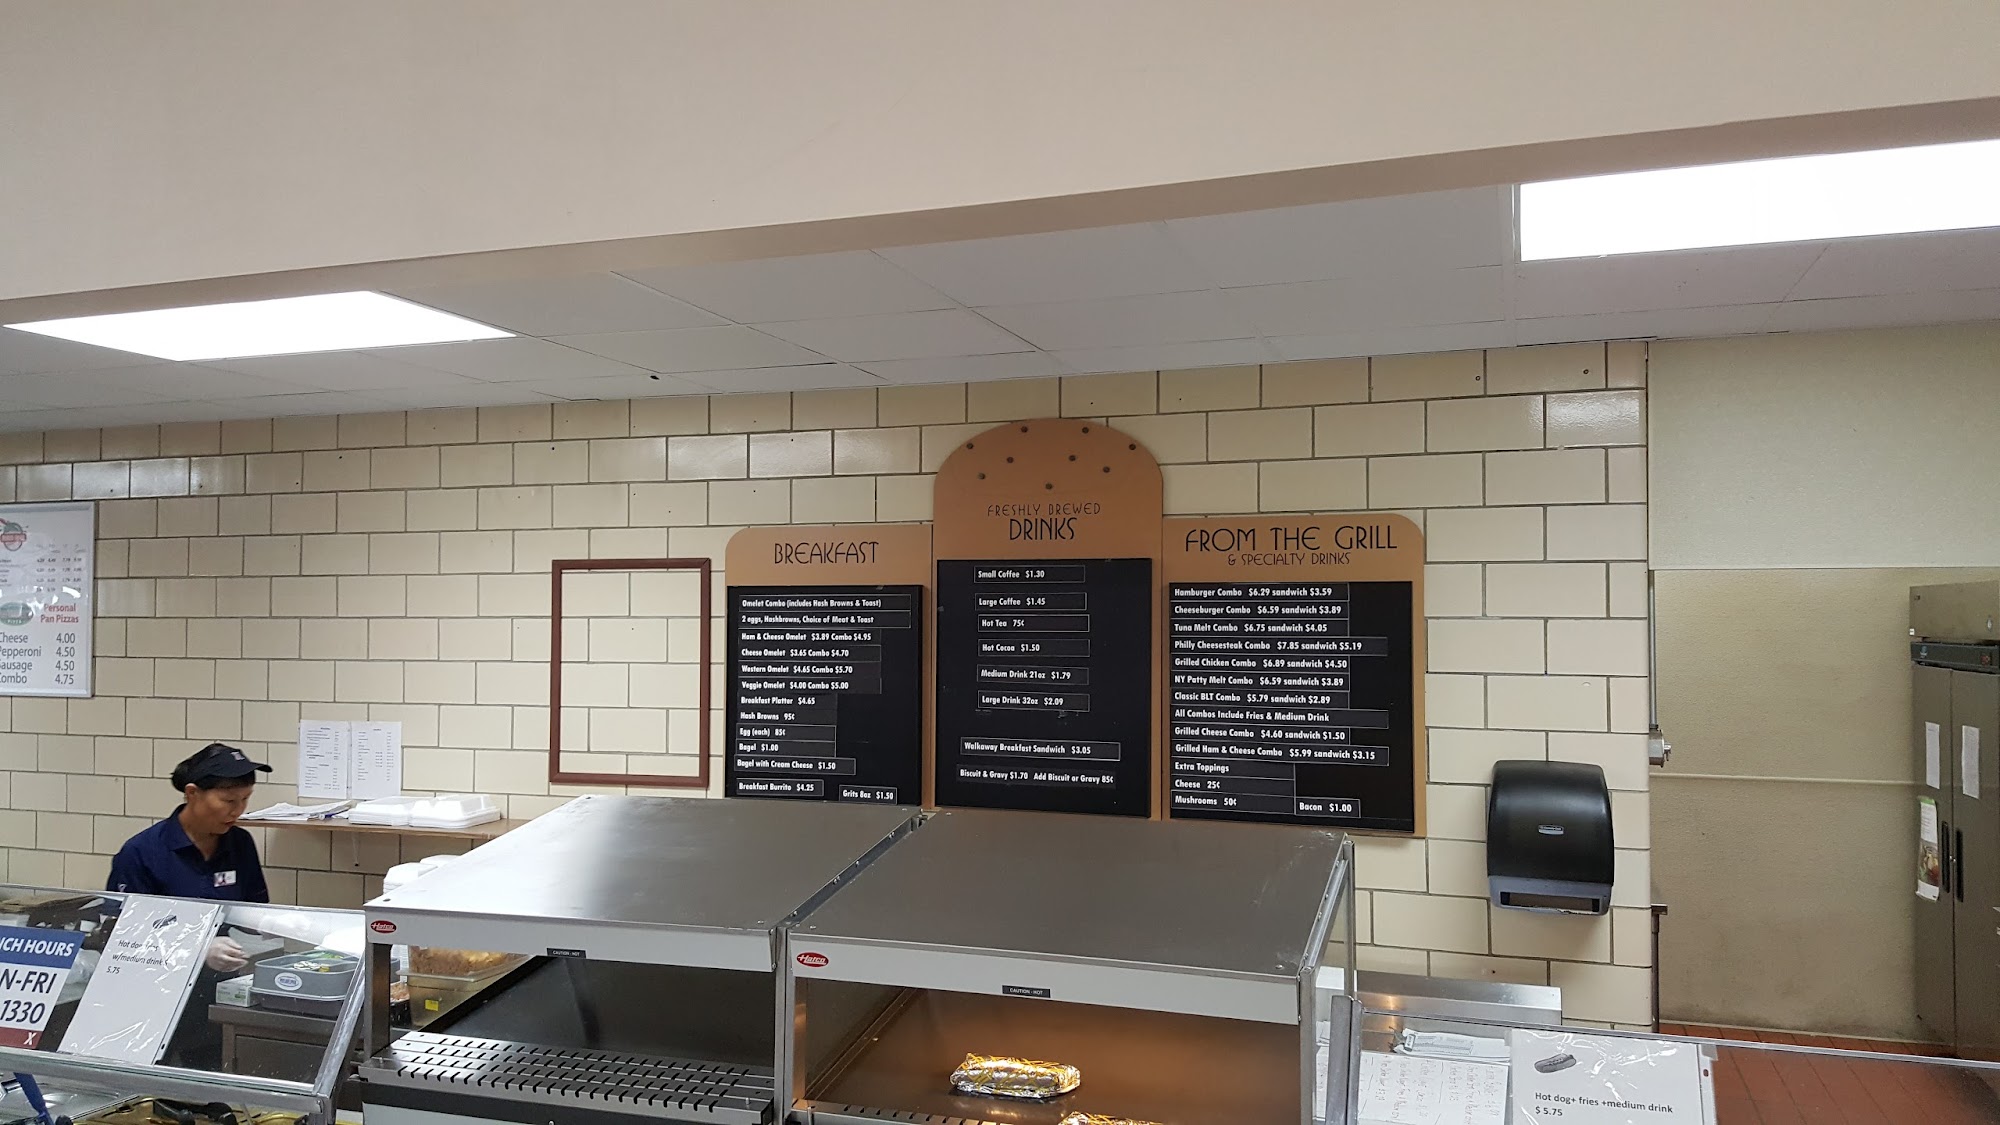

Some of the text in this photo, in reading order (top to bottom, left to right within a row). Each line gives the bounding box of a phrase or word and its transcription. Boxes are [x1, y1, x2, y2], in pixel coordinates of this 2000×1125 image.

[988, 503, 1100, 516] FRESHLY BREWED
[1010, 517, 1077, 540] DRINKS
[1186, 525, 1397, 551] FROM THE GRILL
[775, 541, 879, 564] BREAKFAST
[1228, 552, 1350, 565] & SPECIALTY DRINKS
[998, 570, 1019, 578] Coffee
[1026, 570, 1044, 578] $1.30
[1175, 588, 1332, 597] Hamburger Combo $6.29 sandwich $3.59
[979, 598, 997, 607] Large
[1027, 598, 1045, 606] $1.45
[44, 604, 76, 612] Personal
[1175, 606, 1224, 615] Cheeseburger
[1258, 606, 1279, 614] $6.59
[1319, 606, 1341, 614] $3.89
[41, 615, 79, 623] Pan Pizzas
[56, 633, 76, 643] 4.00
[812, 633, 829, 641] $3.89
[854, 633, 871, 641] $4.95
[1175, 641, 1195, 650] Philly
[1197, 641, 1242, 649] Cheesesteak
[1245, 641, 1270, 649] Combo
[1277, 642, 1299, 650] $7.85
[1340, 642, 1362, 650] $5.19
[56, 647, 75, 657] 4.50
[832, 649, 849, 657] $4.70
[0, 661, 75, 673] ausage 4.50
[1175, 658, 1347, 668] Grilled Chicken Combo $6.89 sandwich $4.50
[55, 674, 74, 684] 4.75
[1010, 670, 1027, 678] Drink
[1051, 671, 1070, 679] $1.79
[798, 697, 815, 705] $4.65
[982, 696, 1000, 704] Large
[1002, 696, 1020, 704] Drink
[1044, 697, 1063, 705] $2.09
[1175, 709, 1329, 721] All Combos Include Fries & Medium Drink
[740, 728, 750, 736] Egg
[739, 743, 756, 752] Bagel
[965, 742, 1090, 754] Walkaway Breakfast Sandwich $3.05
[1176, 744, 1200, 752] Grilled
[1203, 745, 1219, 753] Ham
[1229, 746, 1255, 754] Cheese
[1257, 747, 1282, 756] Combo
[1290, 749, 1311, 757] $5.99
[1314, 750, 1350, 758] sandwich
[1353, 751, 1375, 759] $3.15
[1175, 762, 1229, 773] Extra Toppings
[960, 769, 981, 777] Biscuit
[990, 771, 1008, 780] Gravy
[1048, 773, 1070, 781] Biscuit
[1080, 775, 1100, 784] Gravy
[1175, 779, 1200, 788] Cheese
[876, 791, 893, 799] $1.50
[1175, 796, 1217, 805] Mushrooms
[1300, 802, 1352, 812] Bacon $1.00
[23, 940, 75, 957] HOURS
[118, 940, 130, 948] Hot
[106, 966, 121, 974] 5.75
[1535, 1092, 1551, 1101] Hot
[1579, 1096, 1599, 1106] fries
[1648, 1103, 1674, 1114] drink
[1535, 1106, 1563, 1116] $ 5.75
